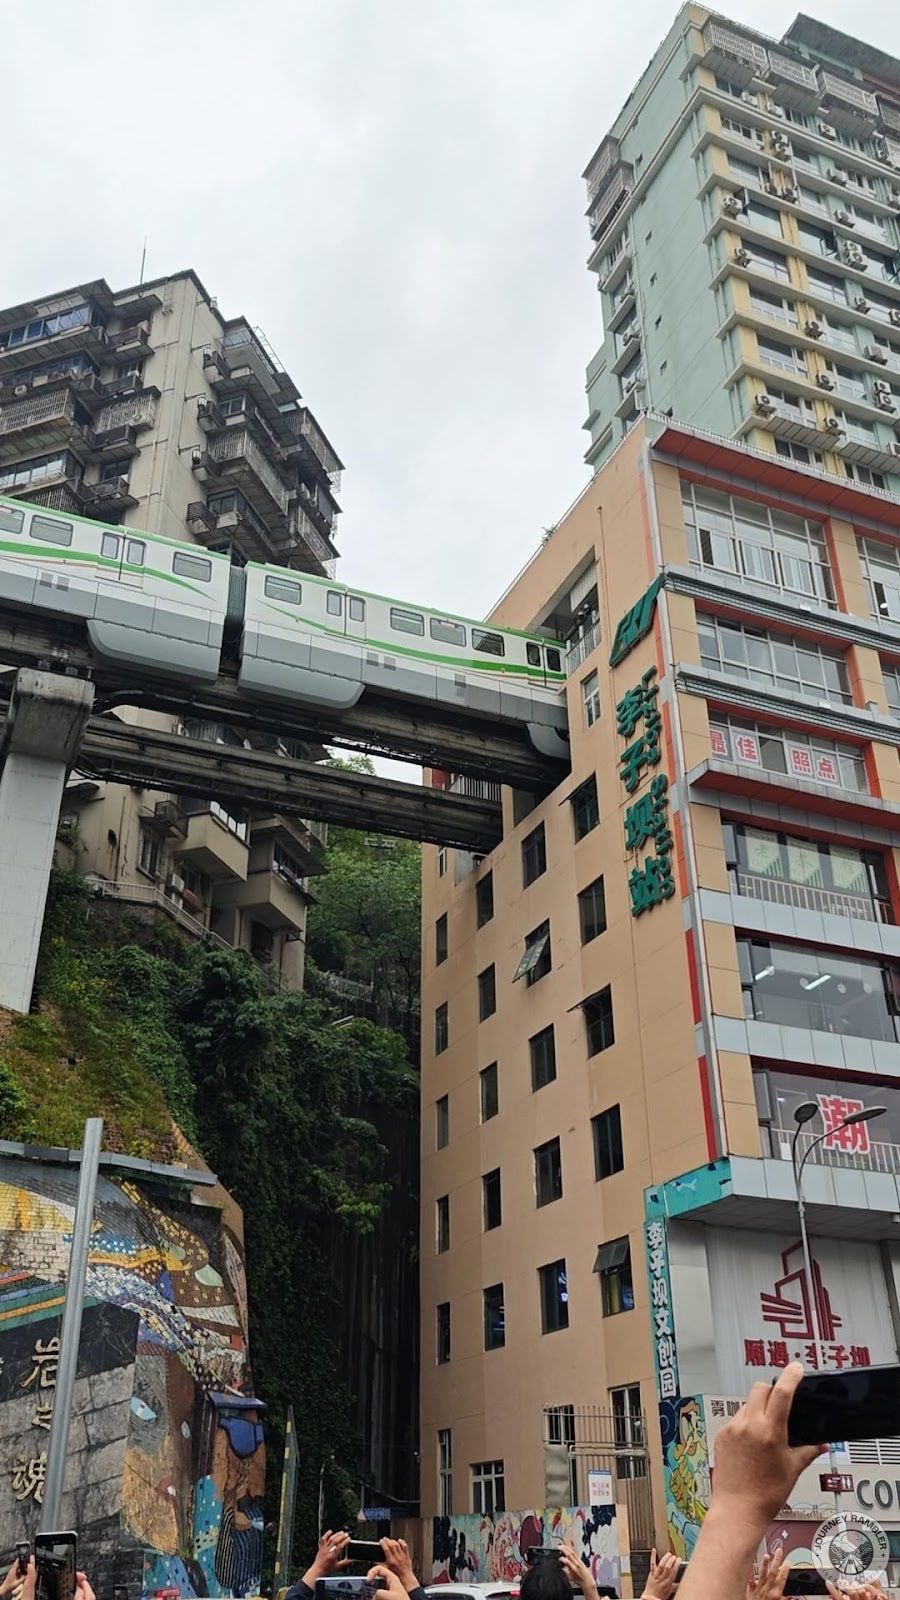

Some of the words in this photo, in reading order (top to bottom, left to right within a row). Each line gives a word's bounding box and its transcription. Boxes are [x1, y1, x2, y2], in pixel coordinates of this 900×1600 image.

[616, 684, 663, 918] 李子坝站
[816, 1094, 870, 1154] 潮
[647, 1221, 677, 1398] 李子坝文创园
